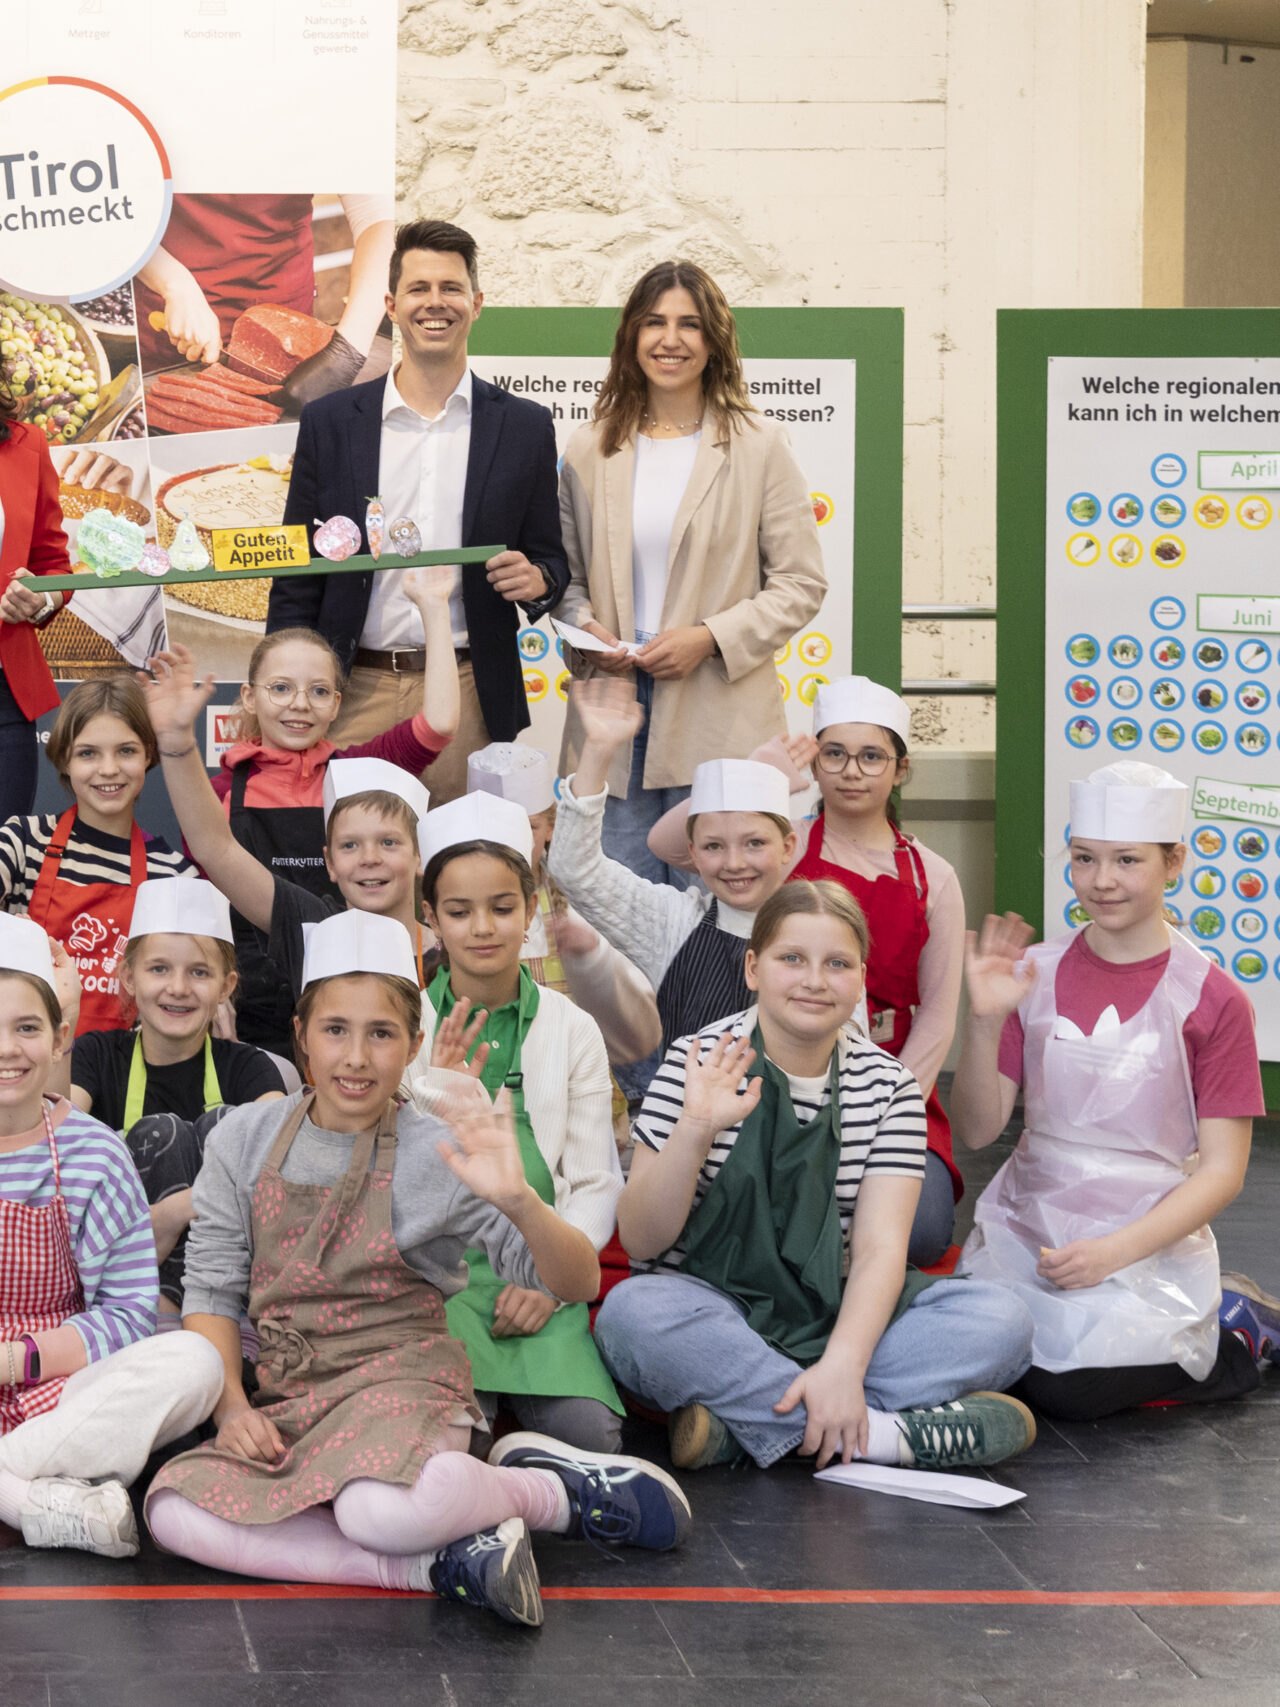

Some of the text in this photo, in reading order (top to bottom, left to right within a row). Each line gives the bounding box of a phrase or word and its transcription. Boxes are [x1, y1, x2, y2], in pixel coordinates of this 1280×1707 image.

[359, 16, 367, 25] &
[68, 28, 111, 40] Metzger
[183, 29, 241, 39] Konditoren
[302, 29, 369, 40] Genussmittel
[312, 44, 359, 55] gewerbe
[493, 375, 567, 393] Welche
[1082, 376, 1280, 398] Welche regionalen
[571, 402, 589, 420] in
[764, 405, 835, 422] essen?
[1068, 403, 1119, 421] kann
[1126, 403, 1157, 422] ich
[1164, 404, 1183, 422] in
[1230, 460, 1278, 481] April
[233, 533, 287, 548] Guten
[229, 546, 295, 567] Appetit
[1232, 608, 1272, 626] Juni
[1195, 789, 1280, 818] Septemb
